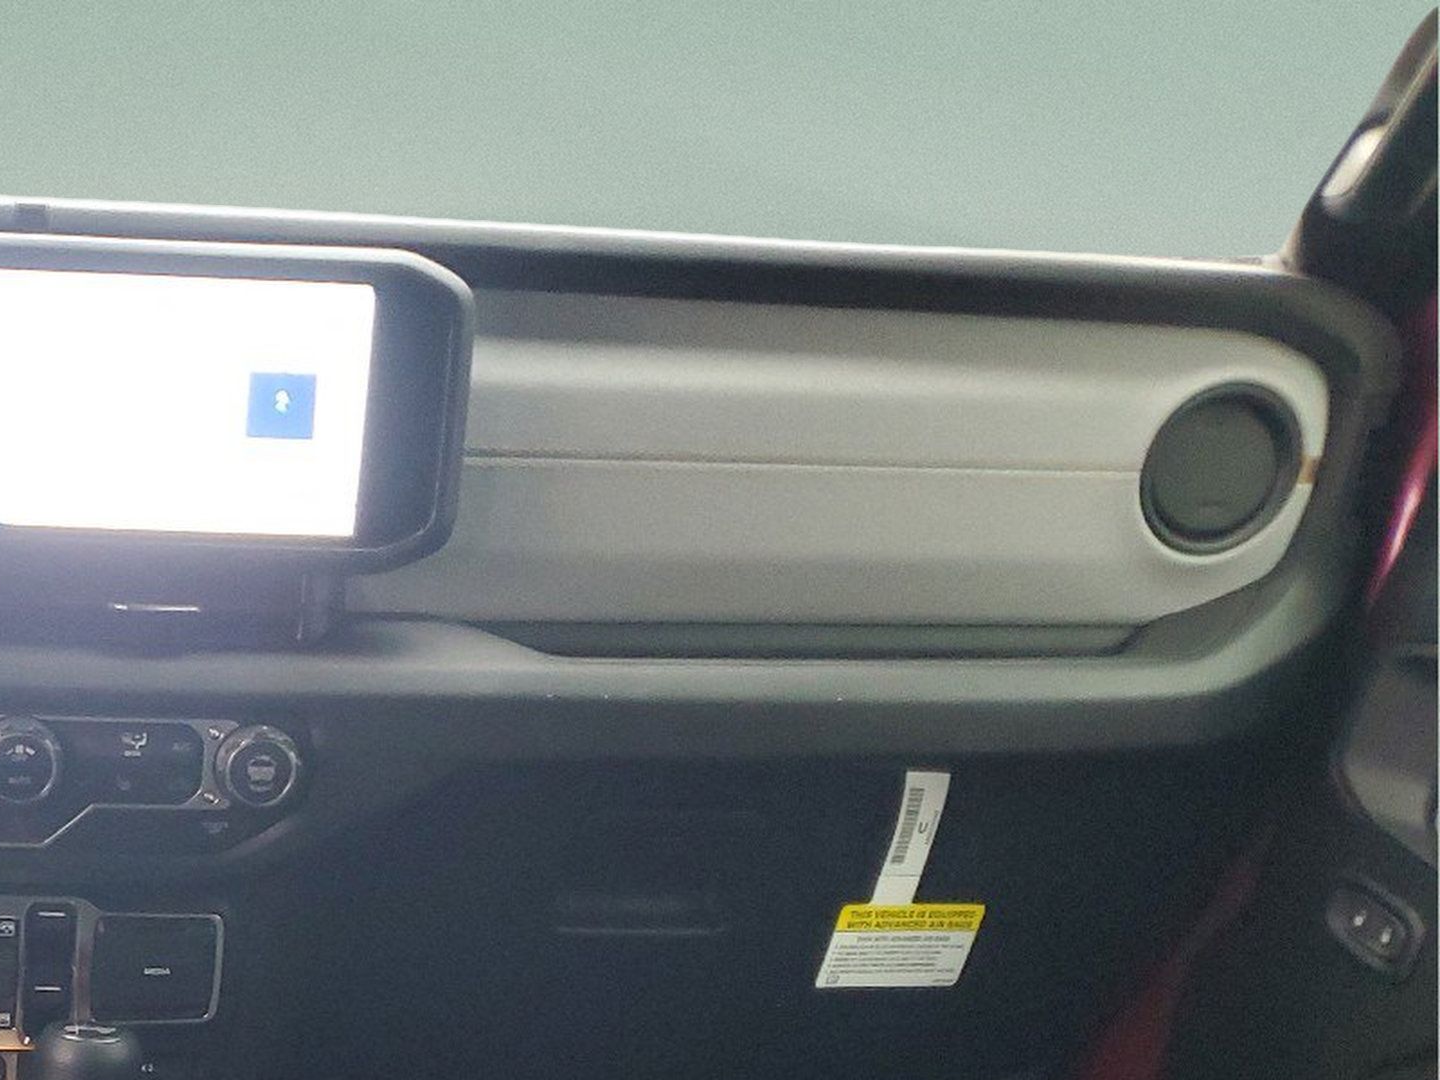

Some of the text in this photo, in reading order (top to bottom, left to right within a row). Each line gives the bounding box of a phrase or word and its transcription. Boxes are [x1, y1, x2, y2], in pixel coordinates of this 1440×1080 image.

[850, 910, 977, 919] THIS VEHICLE IS EQUIPPED
[846, 920, 872, 929] WITH
[874, 920, 927, 928] ADVANCED
